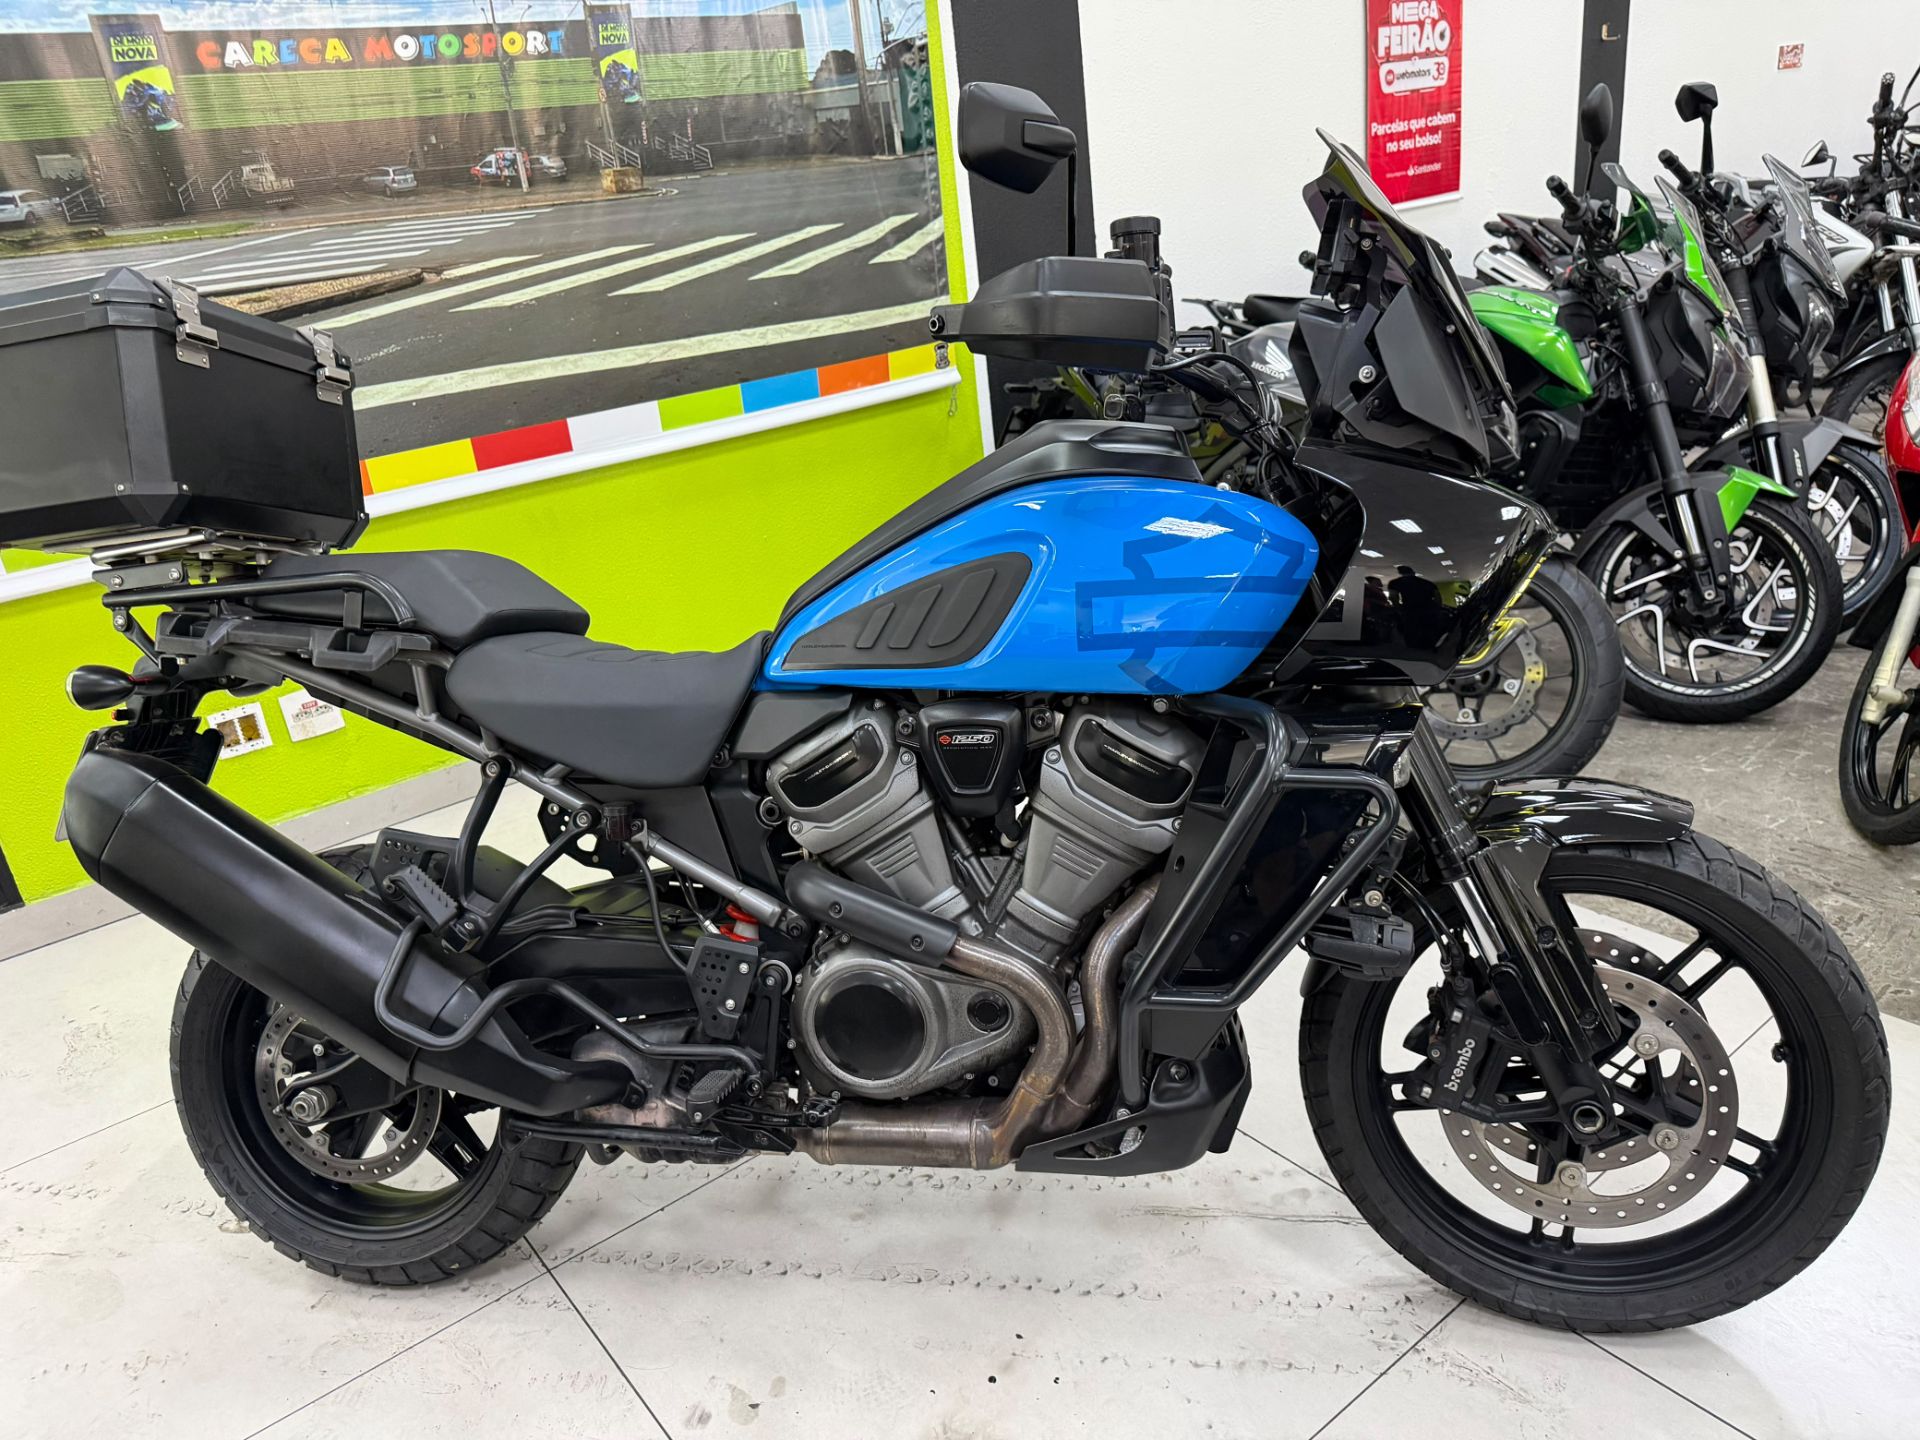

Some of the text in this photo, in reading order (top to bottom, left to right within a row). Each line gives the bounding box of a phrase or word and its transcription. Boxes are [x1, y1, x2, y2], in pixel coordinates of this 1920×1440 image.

[1391, 0, 1439, 24] MEGA
[196, 30, 565, 69] CARECA MOTOSPORT
[602, 33, 628, 44] NOVA
[1377, 18, 1451, 57] FEIRÃO
[115, 47, 155, 60] NOVA
[1396, 69, 1431, 80] webmotors
[1371, 111, 1456, 136] Parcelas que cabem
[1386, 129, 1442, 154] no seu bolso!
[1414, 162, 1442, 175] Santander
[1251, 361, 1286, 380] HONDA
[1793, 448, 1803, 477] ABS
[952, 734, 994, 744] 1250
[1443, 1038, 1476, 1092] brembo
